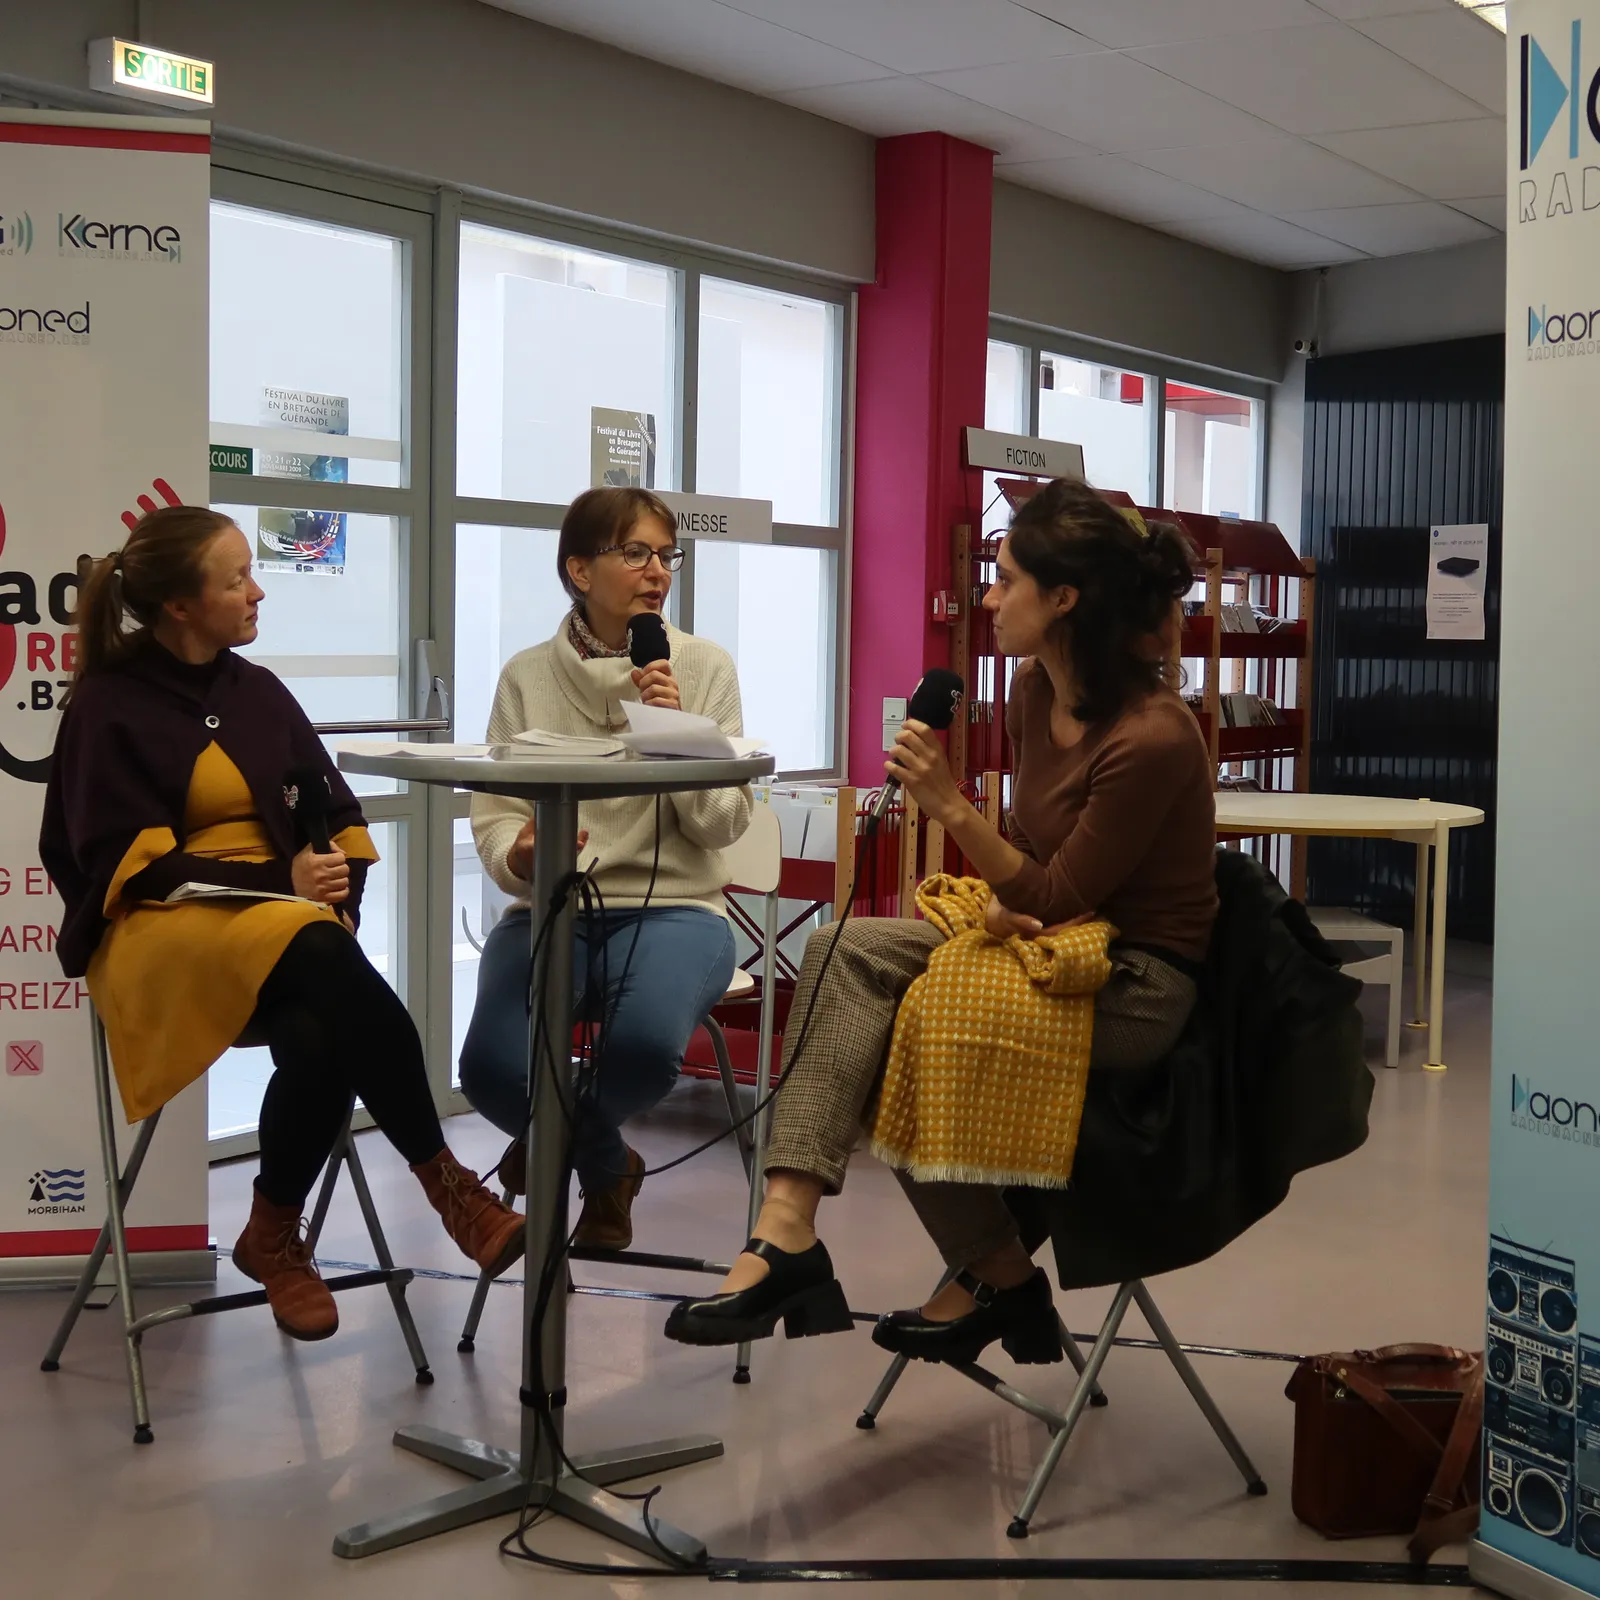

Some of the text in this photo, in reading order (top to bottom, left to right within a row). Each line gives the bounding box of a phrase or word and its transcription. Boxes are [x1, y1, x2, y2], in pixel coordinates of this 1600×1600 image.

[127, 51, 205, 95] SORTIE
[268, 401, 280, 409] EN
[283, 402, 328, 416] BRETAGNE
[306, 395, 319, 404] DU
[322, 397, 345, 408] LIVRE
[209, 451, 247, 468] COURS
[292, 457, 301, 466] 22
[1006, 447, 1046, 469] FICTION
[28, 1205, 85, 1215] MORBIHAN
